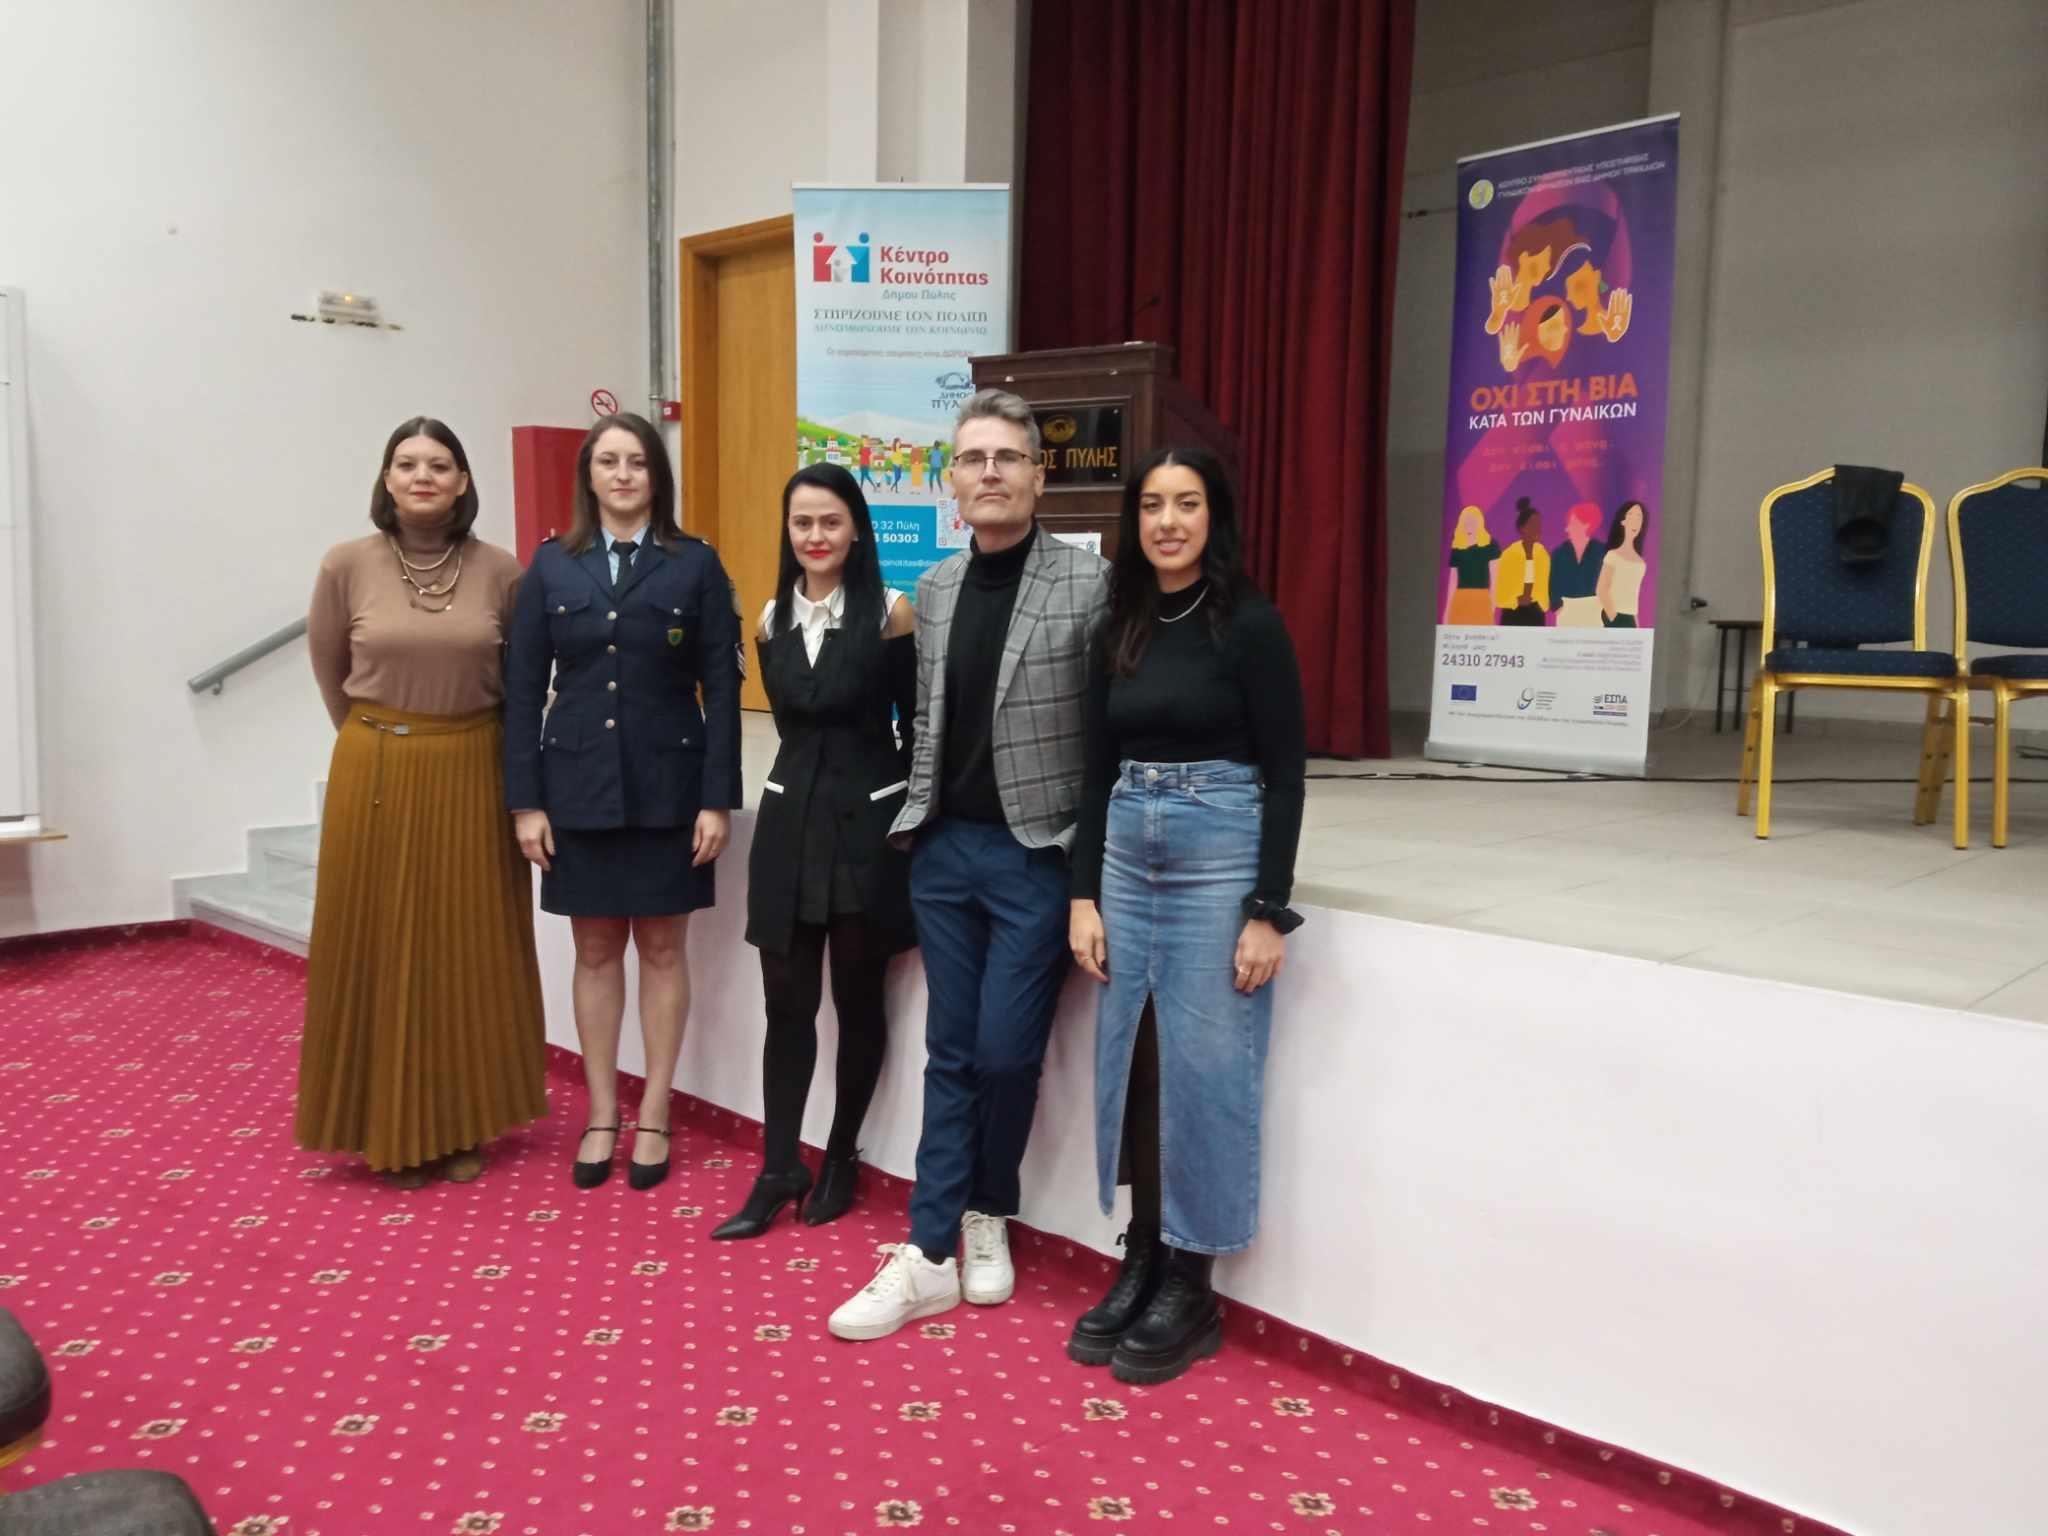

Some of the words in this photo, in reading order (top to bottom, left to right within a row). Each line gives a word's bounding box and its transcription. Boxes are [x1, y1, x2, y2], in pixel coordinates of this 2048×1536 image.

[880, 246, 949, 267] Κέντρο
[880, 267, 988, 286] Κοινότητας
[1470, 384, 1518, 412] ΟΧΙ
[1525, 378, 1582, 406] ΣΤΗ
[1589, 372, 1638, 400] ΒΙΑ
[1469, 411, 1507, 430] ΚΑΤΑ
[1511, 408, 1545, 427] ΤΩΝ
[1550, 401, 1637, 423] ΓΥΝΑΙΚΩΝ
[1066, 446, 1118, 469] ΠΥΛΗΣ
[880, 521, 893, 531] 32
[896, 520, 920, 532] Πύλη
[882, 533, 920, 544] 50303
[1442, 653, 1481, 667] 24310
[1484, 654, 1525, 668] 27943
[1604, 693, 1628, 704] ΕΣΠΑ
